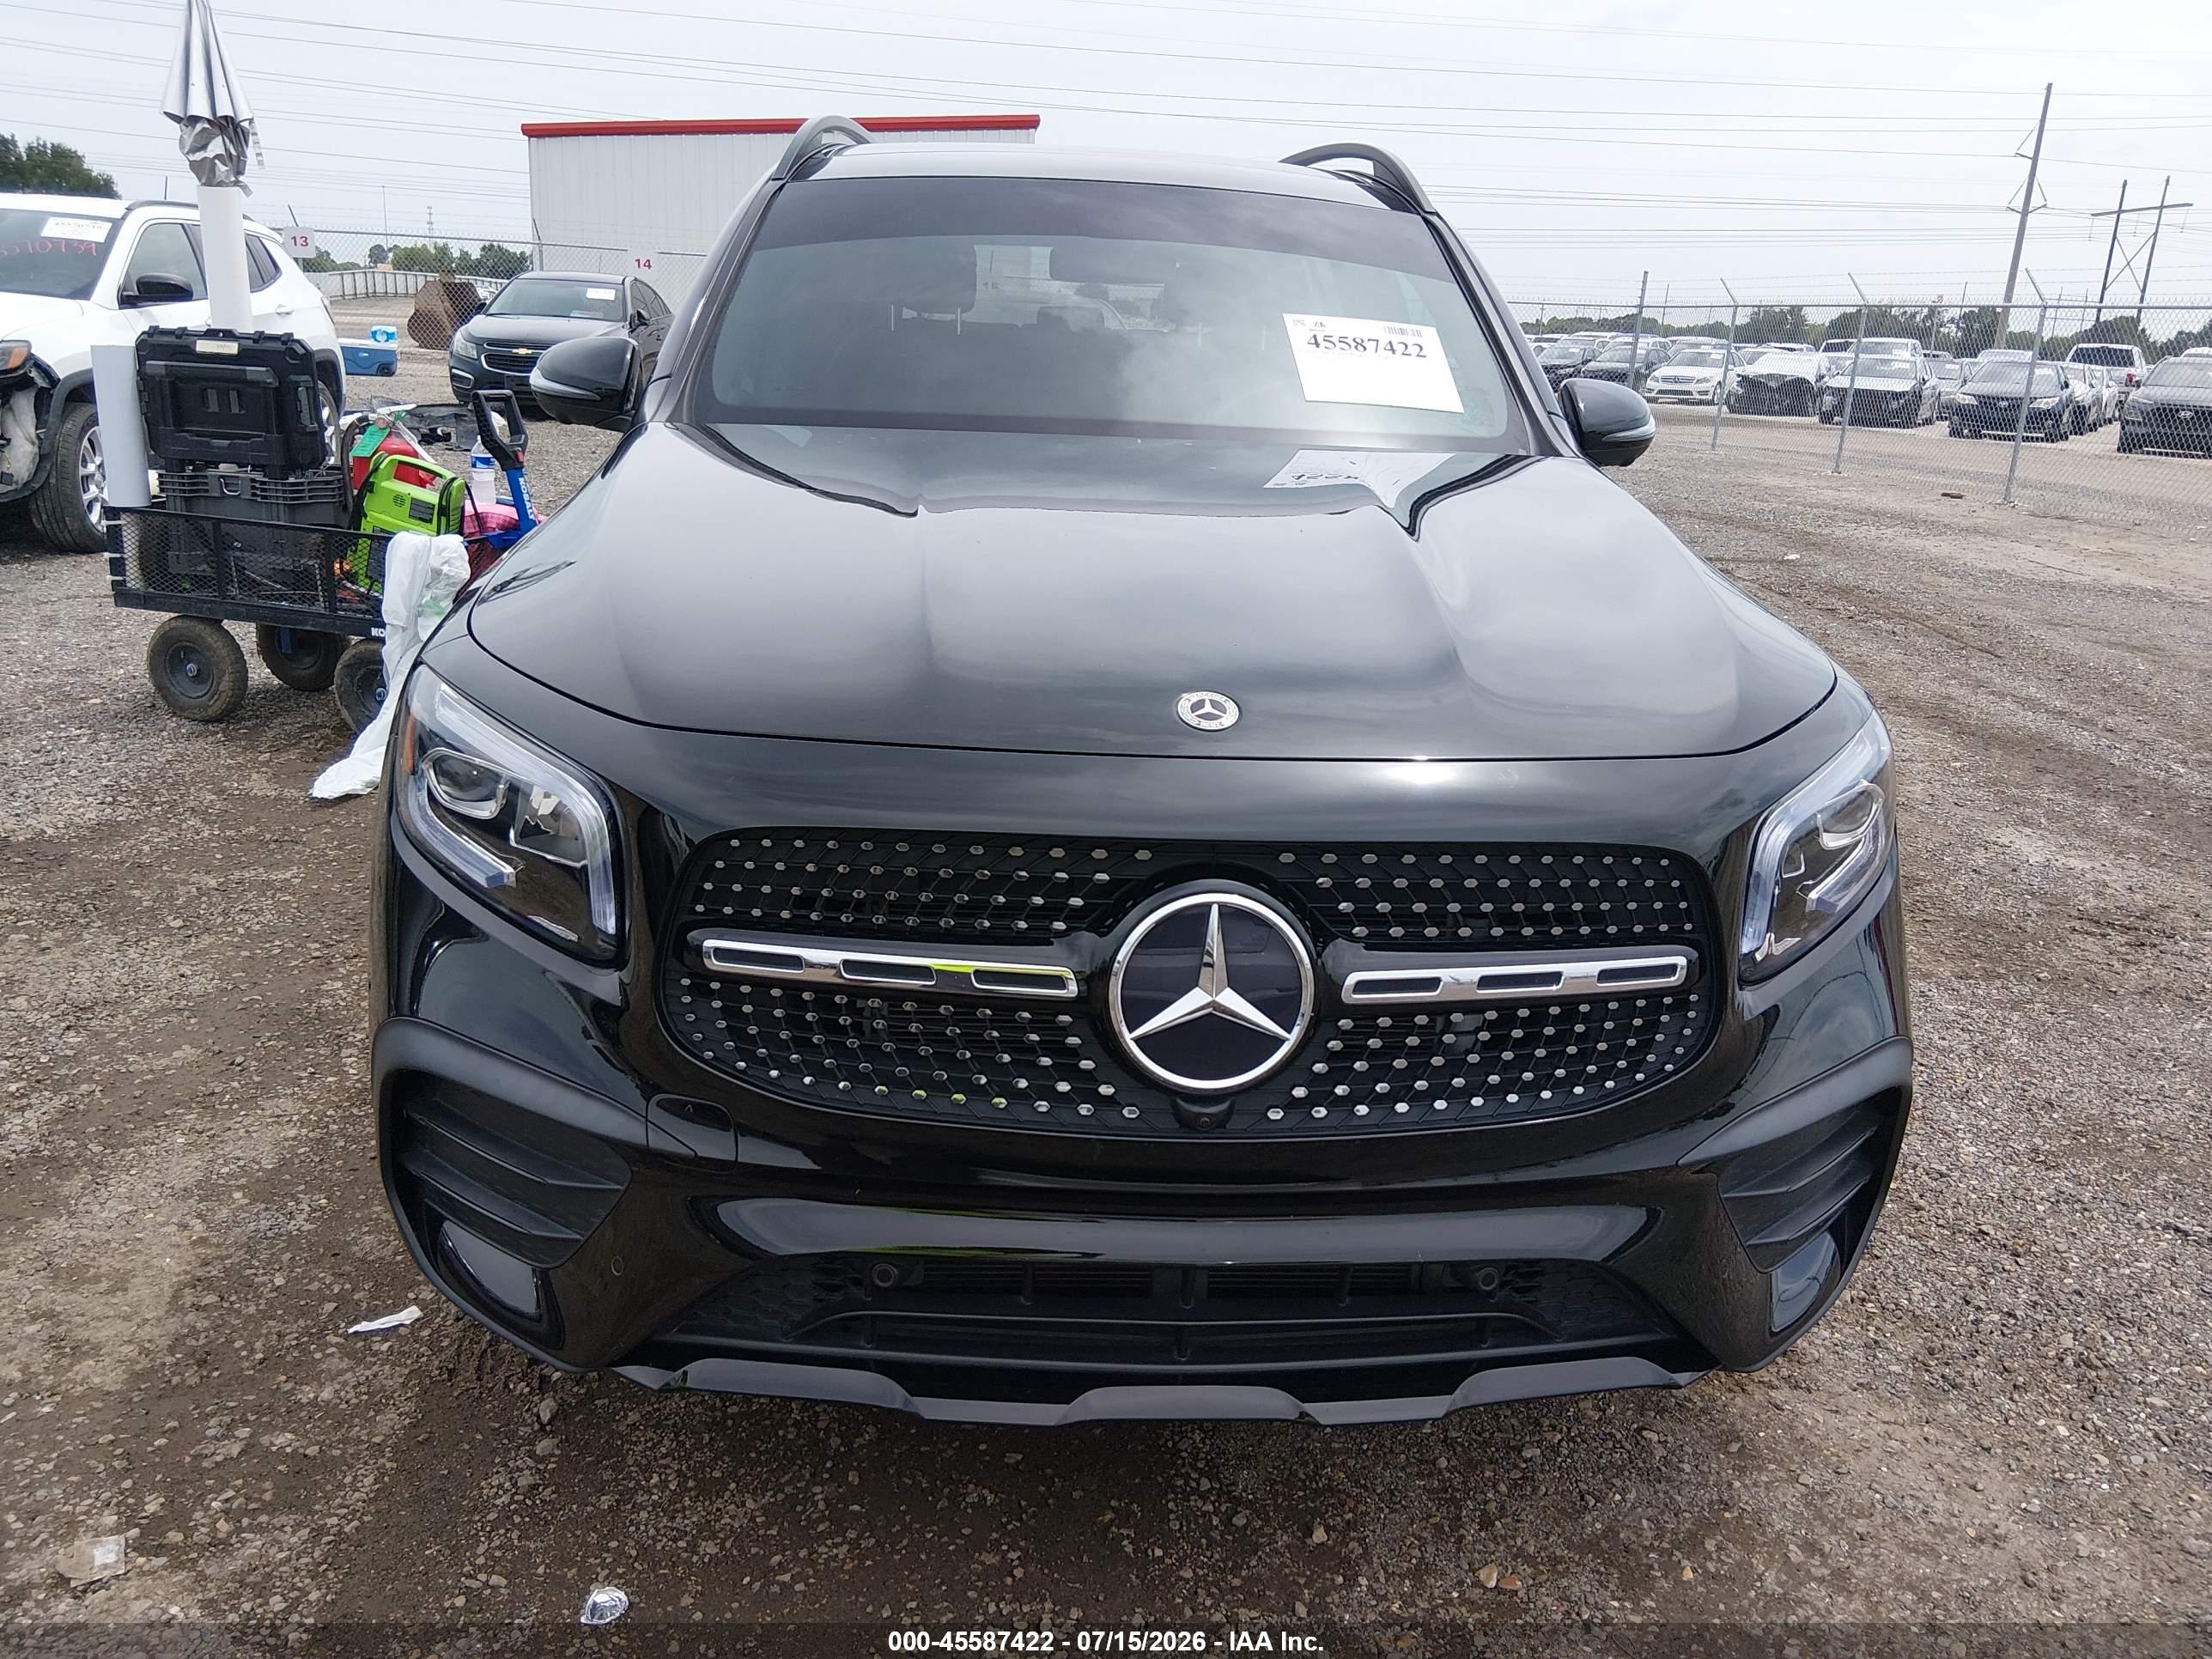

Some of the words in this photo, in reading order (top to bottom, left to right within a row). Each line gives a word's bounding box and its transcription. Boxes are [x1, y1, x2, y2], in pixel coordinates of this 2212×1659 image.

[291, 235, 309, 247] 13
[635, 258, 653, 270] 14
[1307, 333, 1426, 358] 45587422
[518, 477, 536, 520] KOBALT
